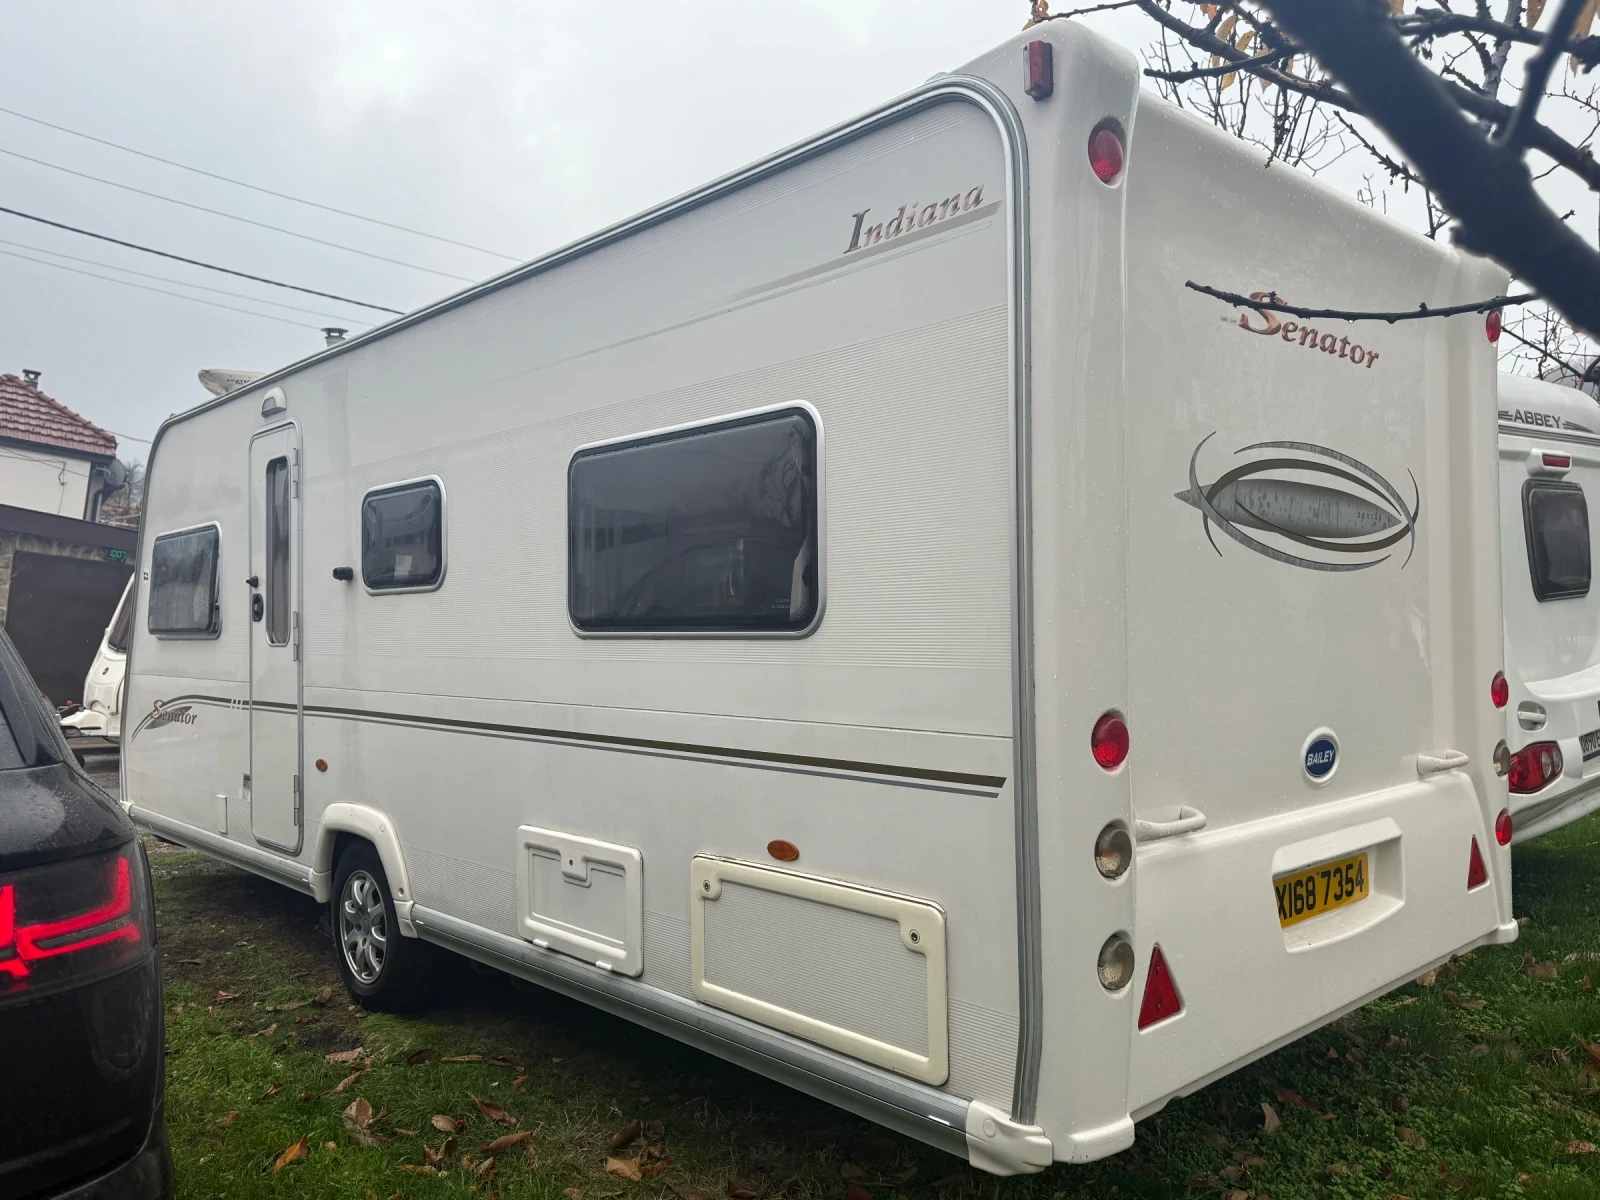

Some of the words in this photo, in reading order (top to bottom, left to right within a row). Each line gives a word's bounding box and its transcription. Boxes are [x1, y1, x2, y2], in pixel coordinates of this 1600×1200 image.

[843, 184, 985, 254] Indiana
[1238, 291, 1380, 369] Senator
[1513, 408, 1561, 429] ABBEY
[150, 699, 198, 725] Senator
[1306, 749, 1335, 767] BAILEY
[1320, 859, 1365, 906] 7354
